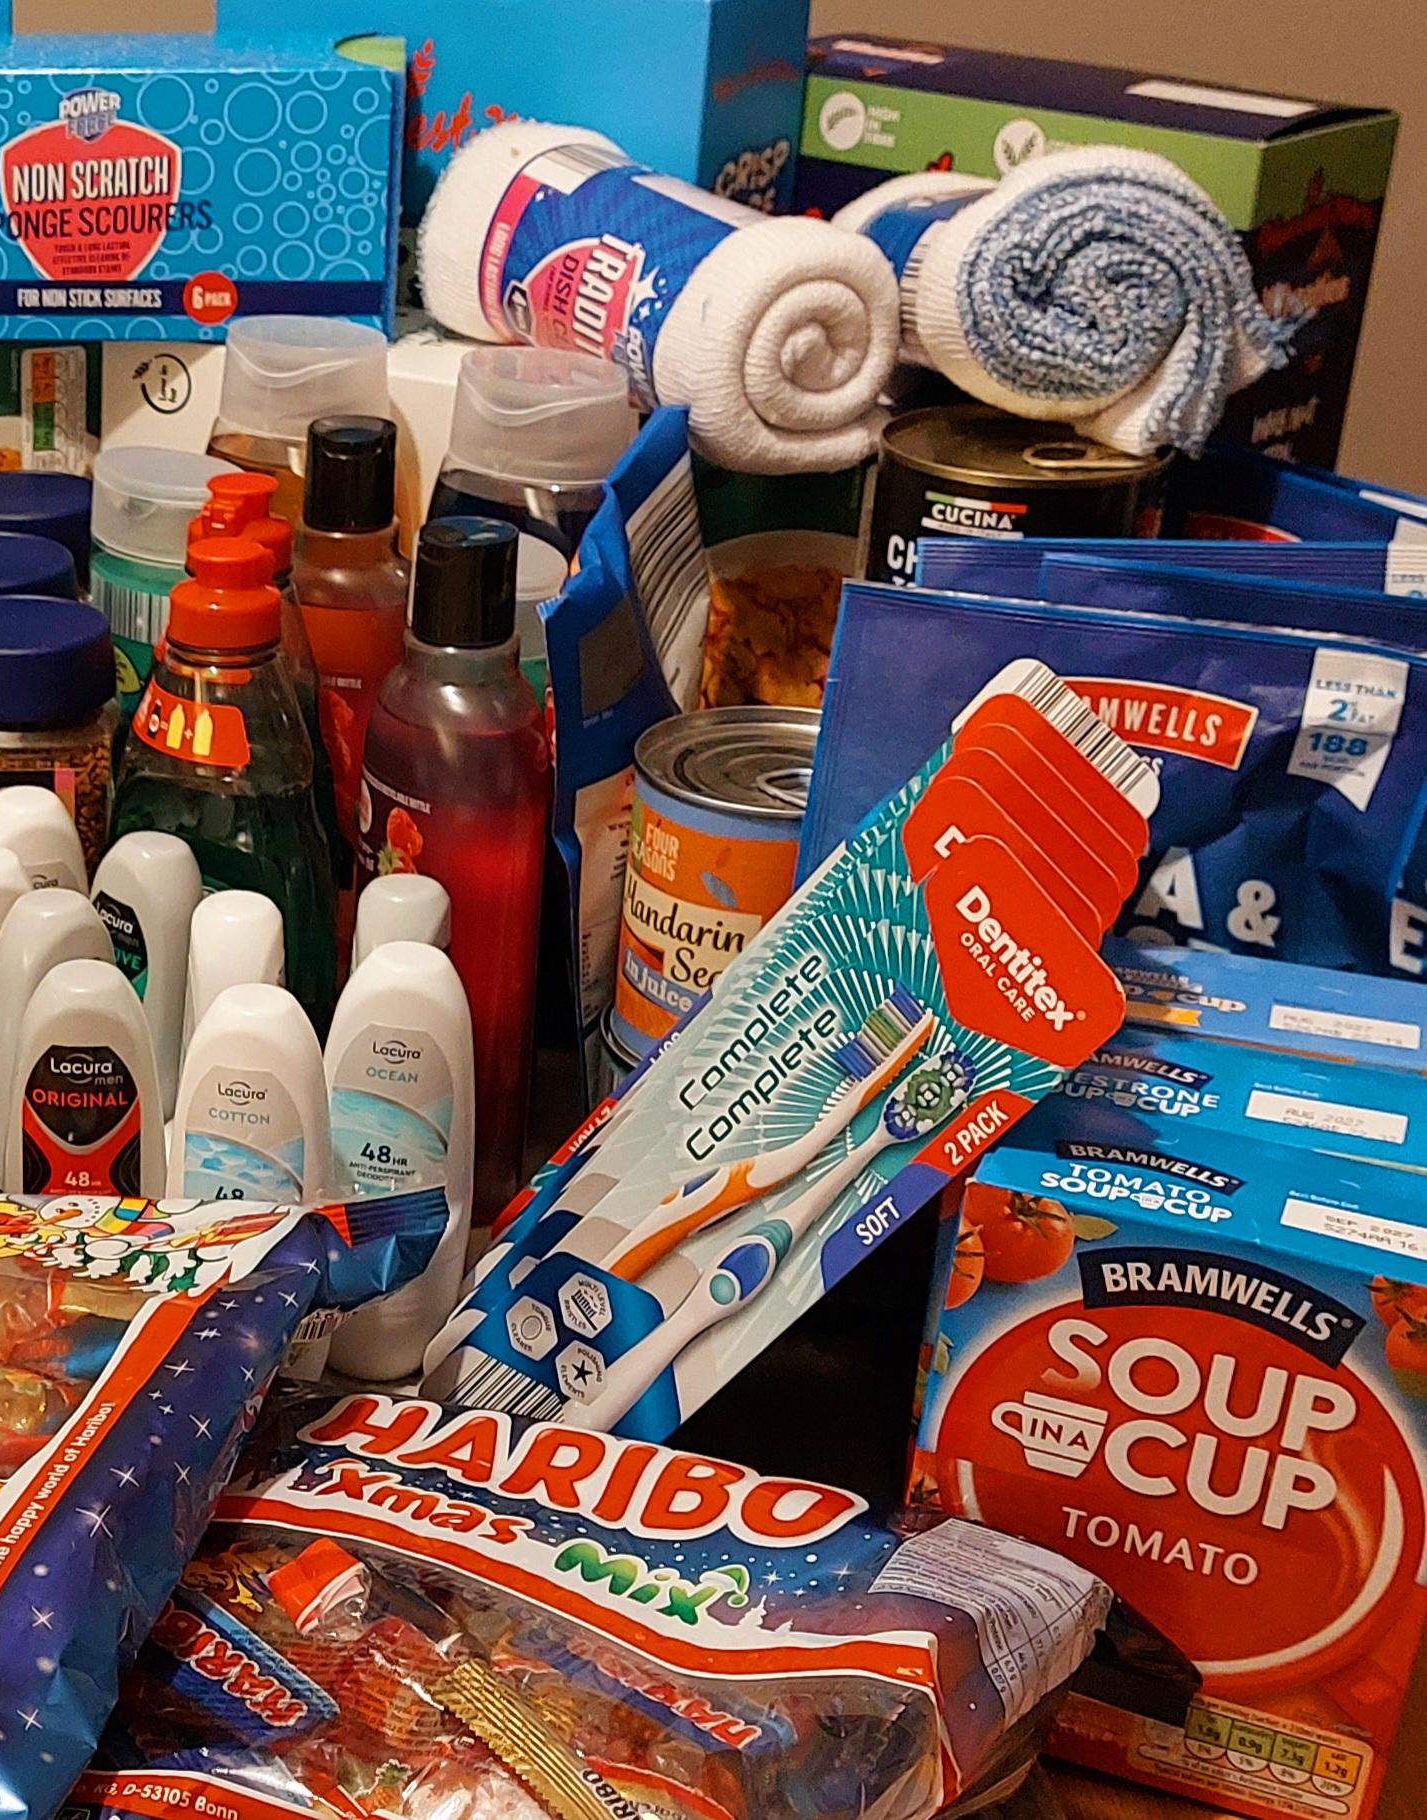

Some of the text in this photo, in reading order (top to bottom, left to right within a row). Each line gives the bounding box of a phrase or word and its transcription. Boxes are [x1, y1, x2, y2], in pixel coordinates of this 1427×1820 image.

[58, 93, 121, 119] POWER
[12, 154, 170, 203] NON SCRATCH
[78, 200, 213, 237] SCOURERS
[17, 288, 163, 308] FOR NON STICK SURFACES
[192, 286, 204, 309] 6
[553, 255, 580, 315] DISH
[930, 503, 1013, 530] CUCINA
[1315, 680, 1398, 699] LESS THAN
[1309, 732, 1369, 757] 188
[646, 823, 680, 859] FOUR
[1227, 879, 1282, 947] &
[955, 885, 1076, 1033] Dentitex
[959, 931, 1036, 1024] ORAL CARE
[641, 971, 694, 1012] juice
[372, 1040, 421, 1061] Lacura
[678, 953, 827, 1112] Complete
[50, 1056, 113, 1074] Lacura
[94, 1075, 123, 1086] men
[365, 1065, 420, 1085] OCEAN
[684, 1005, 839, 1163] Complete
[31, 1088, 129, 1109] ORIGINAL
[217, 1083, 266, 1102] Lacura
[1136, 1097, 1202, 1119] CUP
[208, 1106, 271, 1127] COTTON
[945, 1100, 1011, 1166] 2 PACK
[359, 1142, 409, 1168] 48 HR
[1069, 1144, 1230, 1190] BRAMWELLS
[63, 1170, 90, 1188] 48
[214, 1184, 245, 1200] 48
[1040, 1171, 1234, 1224] SOUP CUP
[1068, 1162, 1212, 1206] TOMATO
[855, 1199, 901, 1247] SOFT
[1101, 1261, 1338, 1342] BRAMWELLS
[1040, 1318, 1358, 1452] SOUP
[0, 1501, 45, 1545] happy
[34, 1463, 70, 1500] world
[63, 1448, 82, 1464] of
[74, 1402, 117, 1448] Haribo!
[308, 1396, 863, 1543] HARIBO
[1029, 1414, 1338, 1531] IN A CUP
[315, 1462, 719, 1626] Xmas Mix
[1062, 1506, 1261, 1587] TOMATO
[122, 1782, 239, 1820] D-53105 Bonn
